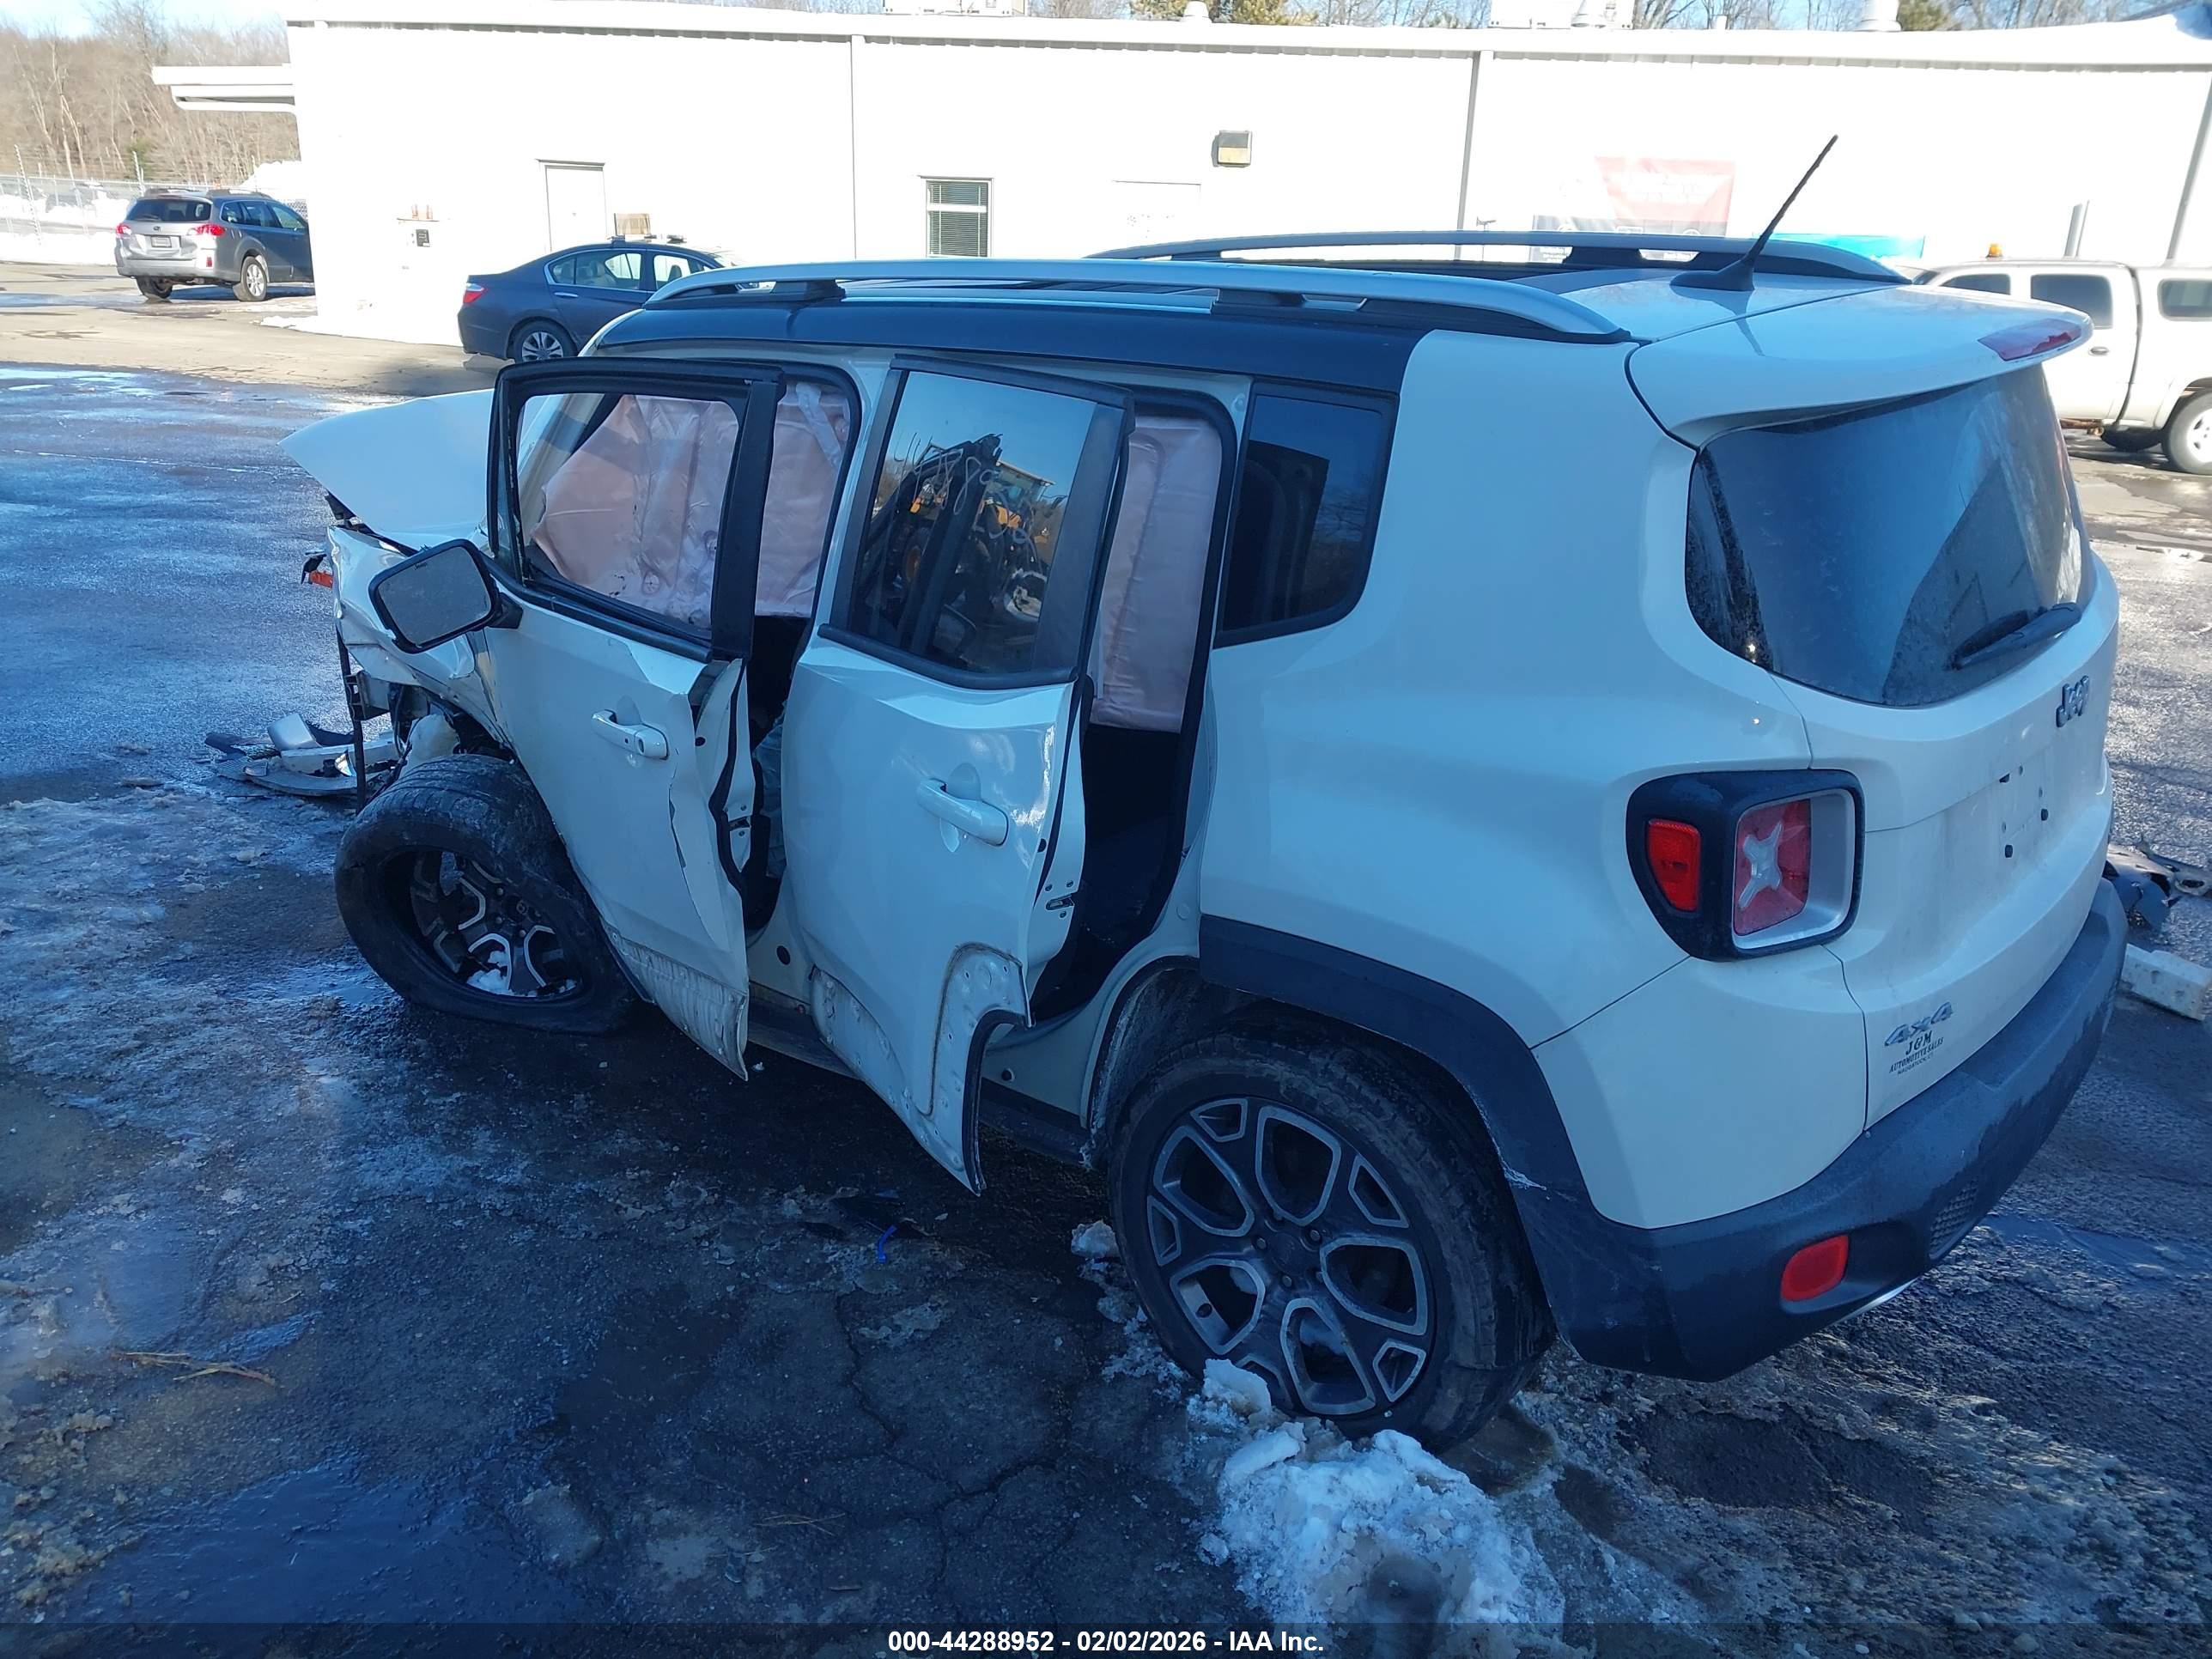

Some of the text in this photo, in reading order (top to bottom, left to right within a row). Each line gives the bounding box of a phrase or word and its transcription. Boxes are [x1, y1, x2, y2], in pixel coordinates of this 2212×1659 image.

[2056, 675, 2089, 727] Jeep
[1888, 1047, 1928, 1073] AUTOMOTIVE
[1927, 1036, 1944, 1053] SALES
